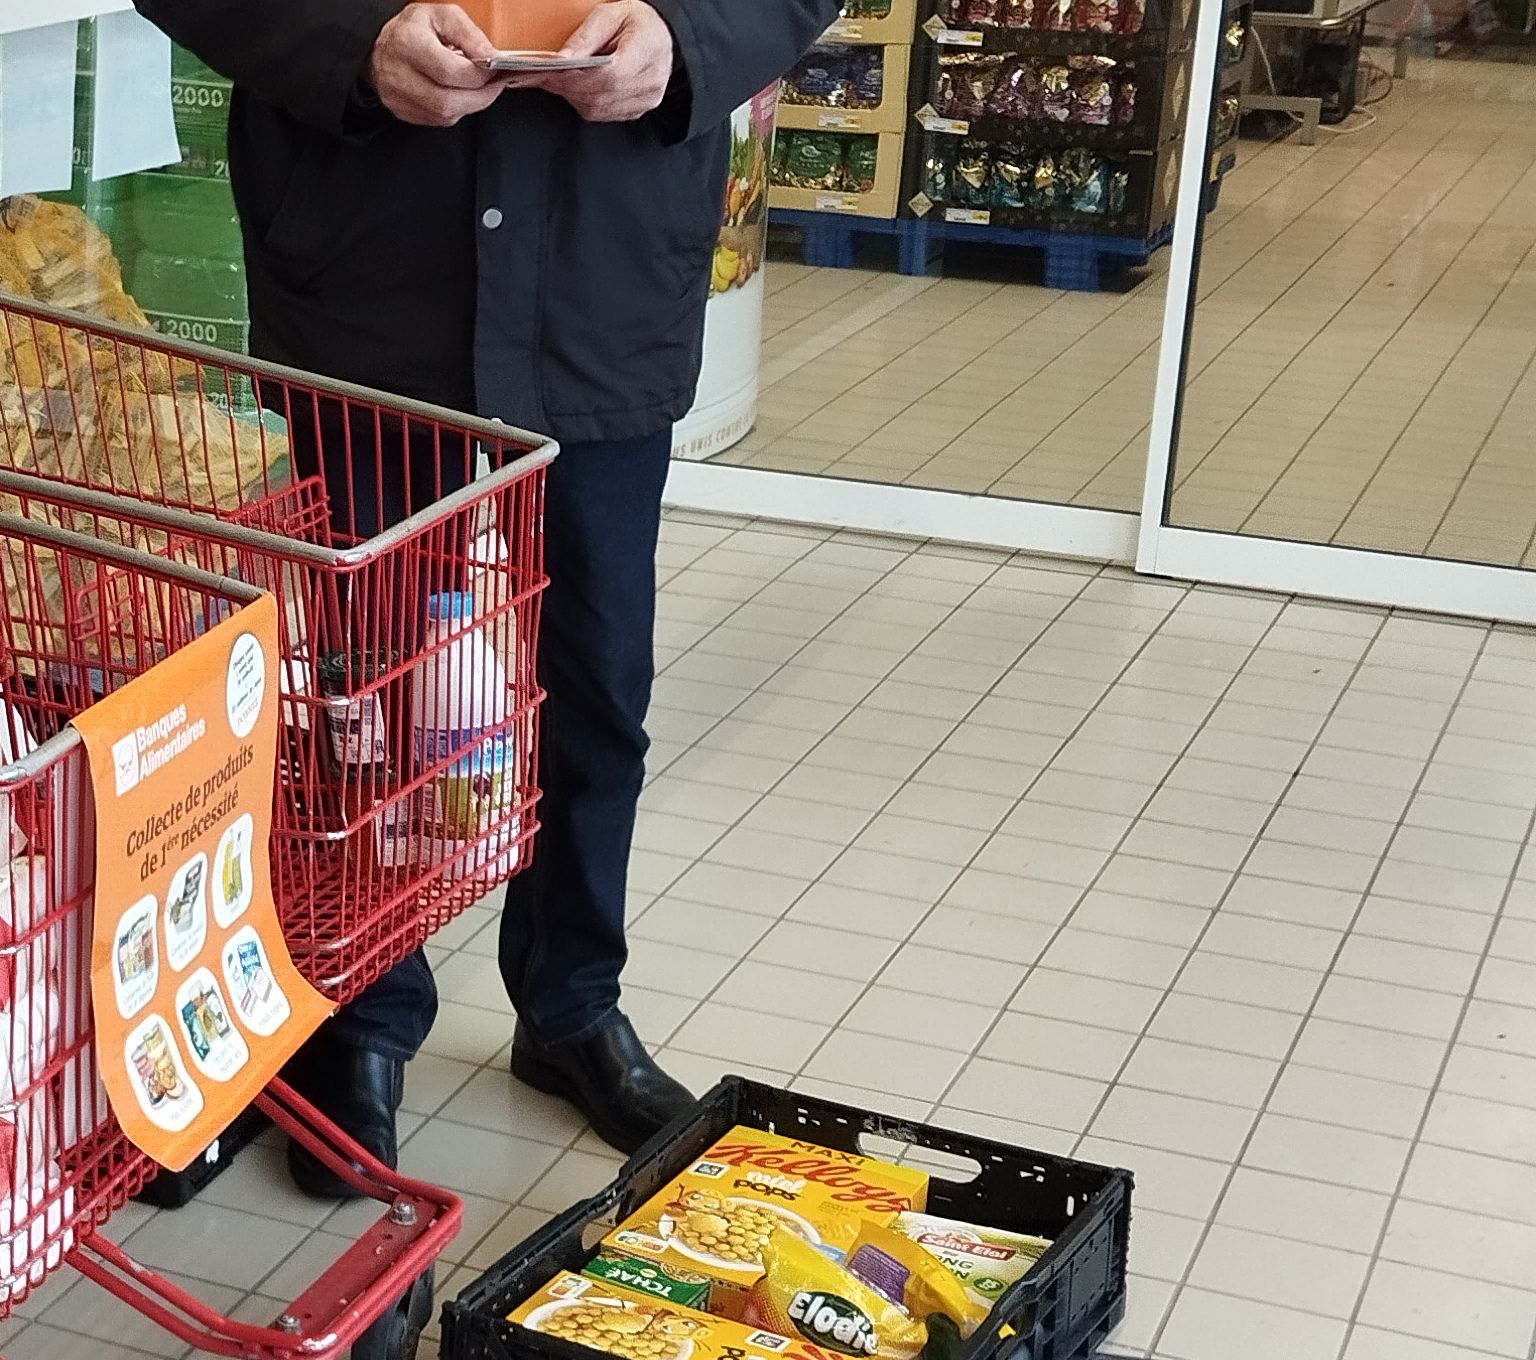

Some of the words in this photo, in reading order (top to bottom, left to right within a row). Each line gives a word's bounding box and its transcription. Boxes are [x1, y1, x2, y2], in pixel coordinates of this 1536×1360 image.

[172, 85, 224, 109] 2000
[166, 319, 218, 343] 2000
[138, 703, 188, 749] Banques
[139, 718, 206, 781] Alimentaires
[126, 802, 184, 857] Collecte
[184, 787, 201, 814] de
[202, 743, 254, 799] produits
[140, 856, 159, 883] de
[180, 782, 240, 852] nécessité
[733, 1178, 802, 1202] pops
